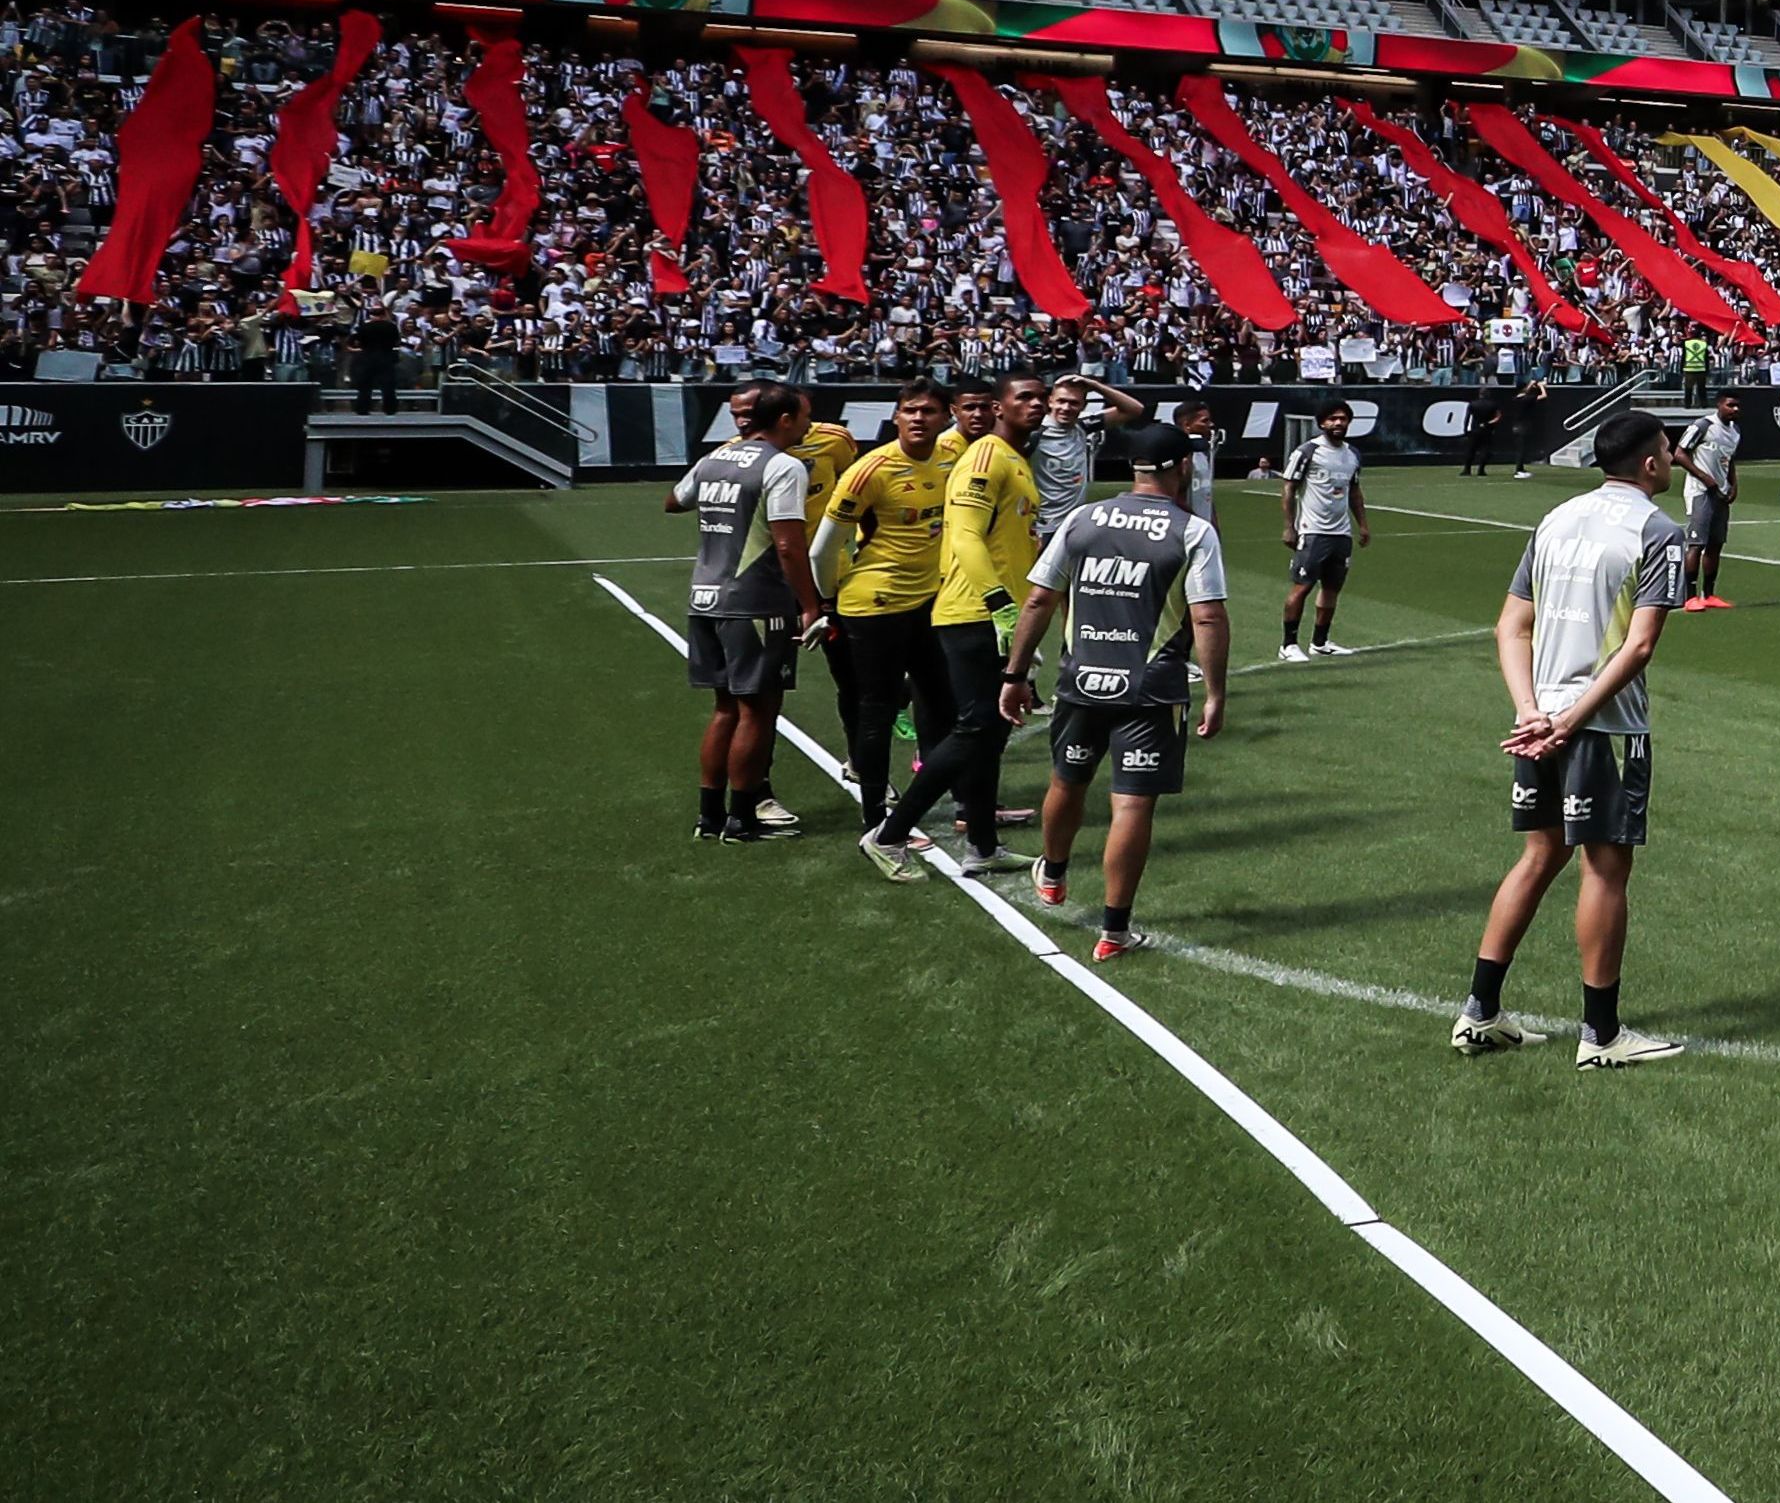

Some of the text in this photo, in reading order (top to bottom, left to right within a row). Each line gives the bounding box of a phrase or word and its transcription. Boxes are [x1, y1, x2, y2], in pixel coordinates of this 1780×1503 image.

[1108, 506, 1171, 542] bmg
[1079, 623, 1140, 643] mundiale
[1083, 673, 1121, 693] BH
[1121, 748, 1161, 768] abc
